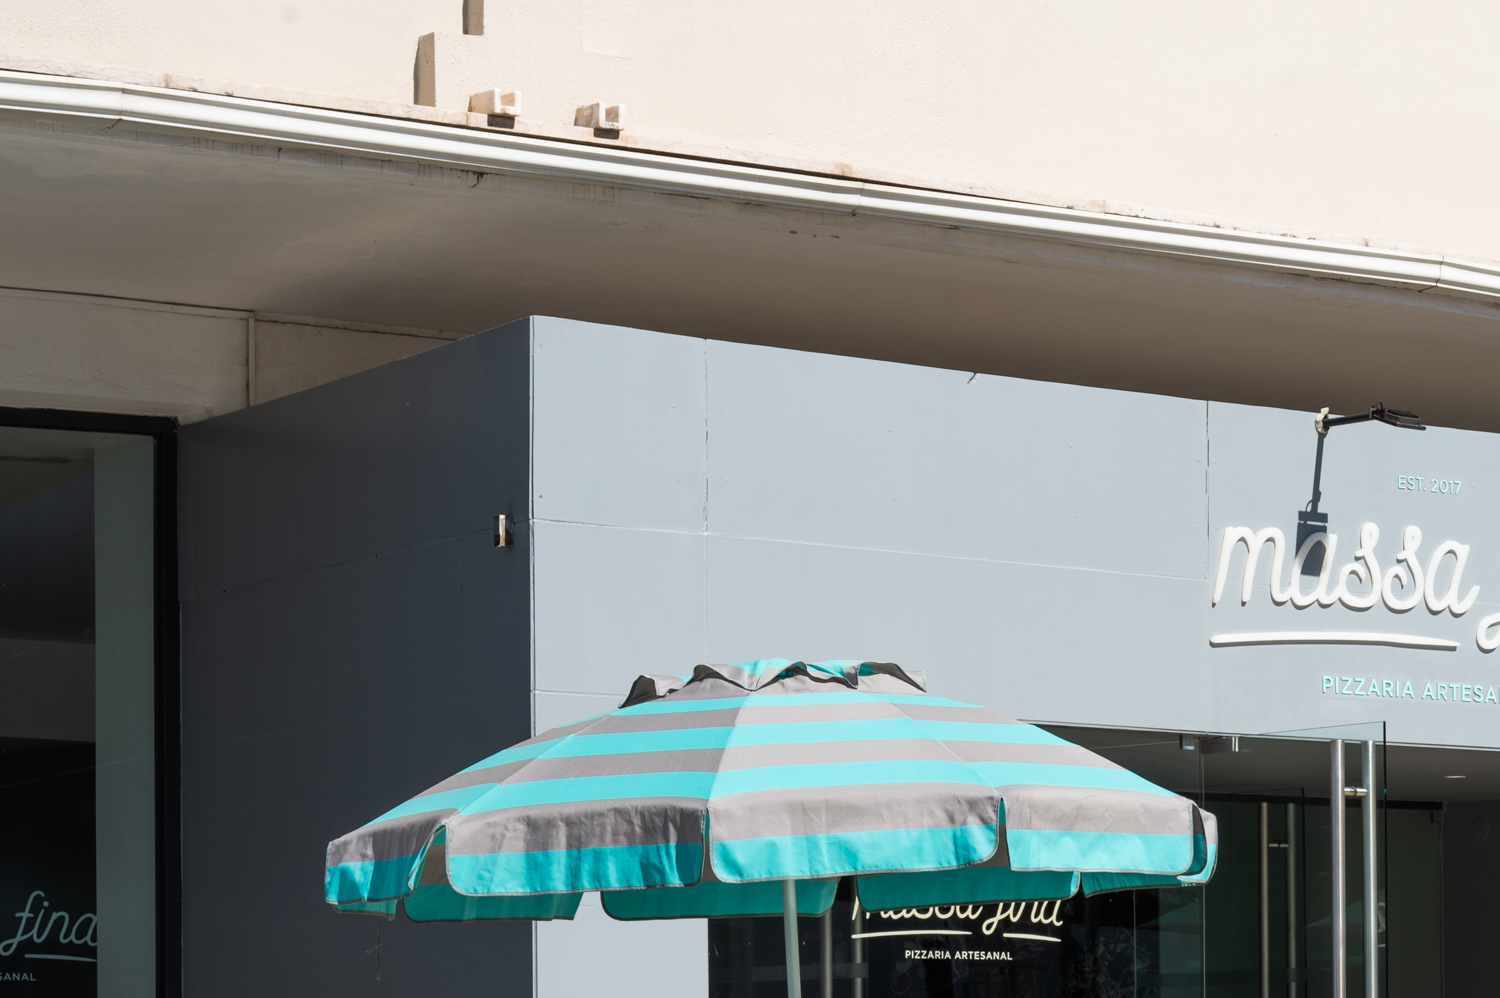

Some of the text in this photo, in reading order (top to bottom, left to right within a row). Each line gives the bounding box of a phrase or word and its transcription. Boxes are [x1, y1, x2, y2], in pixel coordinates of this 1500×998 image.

[1398, 474, 1462, 495] EST. 2017
[1211, 521, 1480, 615] massa
[1321, 674, 1415, 700] PIZZARIA
[0, 890, 98, 957] fina
[904, 950, 1013, 961] PIZZARIA ARTESANAL
